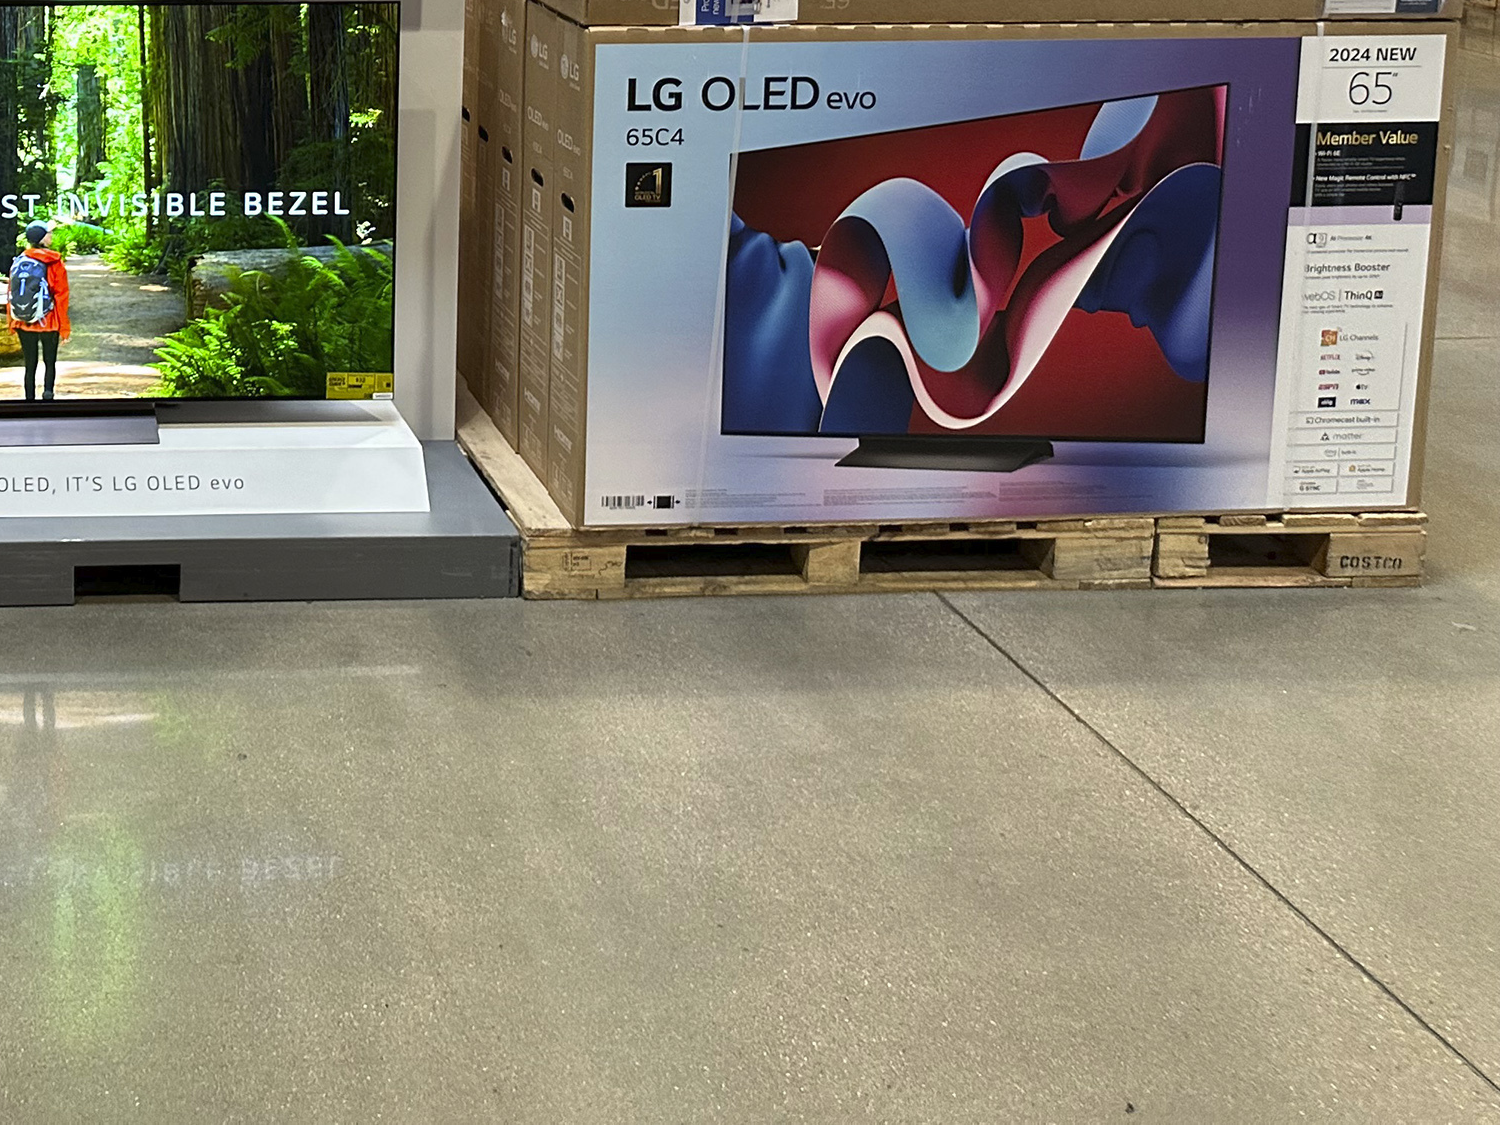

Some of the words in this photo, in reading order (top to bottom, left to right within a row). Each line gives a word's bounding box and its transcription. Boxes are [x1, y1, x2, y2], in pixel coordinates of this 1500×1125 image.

[538, 42, 548, 61] LG
[1328, 47, 1371, 63] 2024
[1376, 47, 1417, 61] NEW
[568, 61, 580, 82] LG
[626, 77, 684, 112] LG
[700, 76, 820, 111] OLED
[826, 90, 877, 110] evo
[527, 105, 543, 127] OLED
[557, 129, 574, 151] OLED
[626, 127, 685, 147] 65C4
[1316, 131, 1376, 146] Member
[1379, 129, 1419, 145] Value
[56, 191, 227, 219] INVISIBLE
[242, 190, 350, 217] BEZEL
[1304, 264, 1351, 275] Brightness
[1354, 263, 1390, 273] Booster
[1344, 291, 1373, 301] ThinQ
[1314, 416, 1355, 424] Chromecast
[65, 475, 104, 493] IT'S
[112, 475, 138, 493] LG
[146, 475, 201, 492] OLED
[210, 477, 245, 491] evo
[1339, 555, 1403, 571] COSTCO
